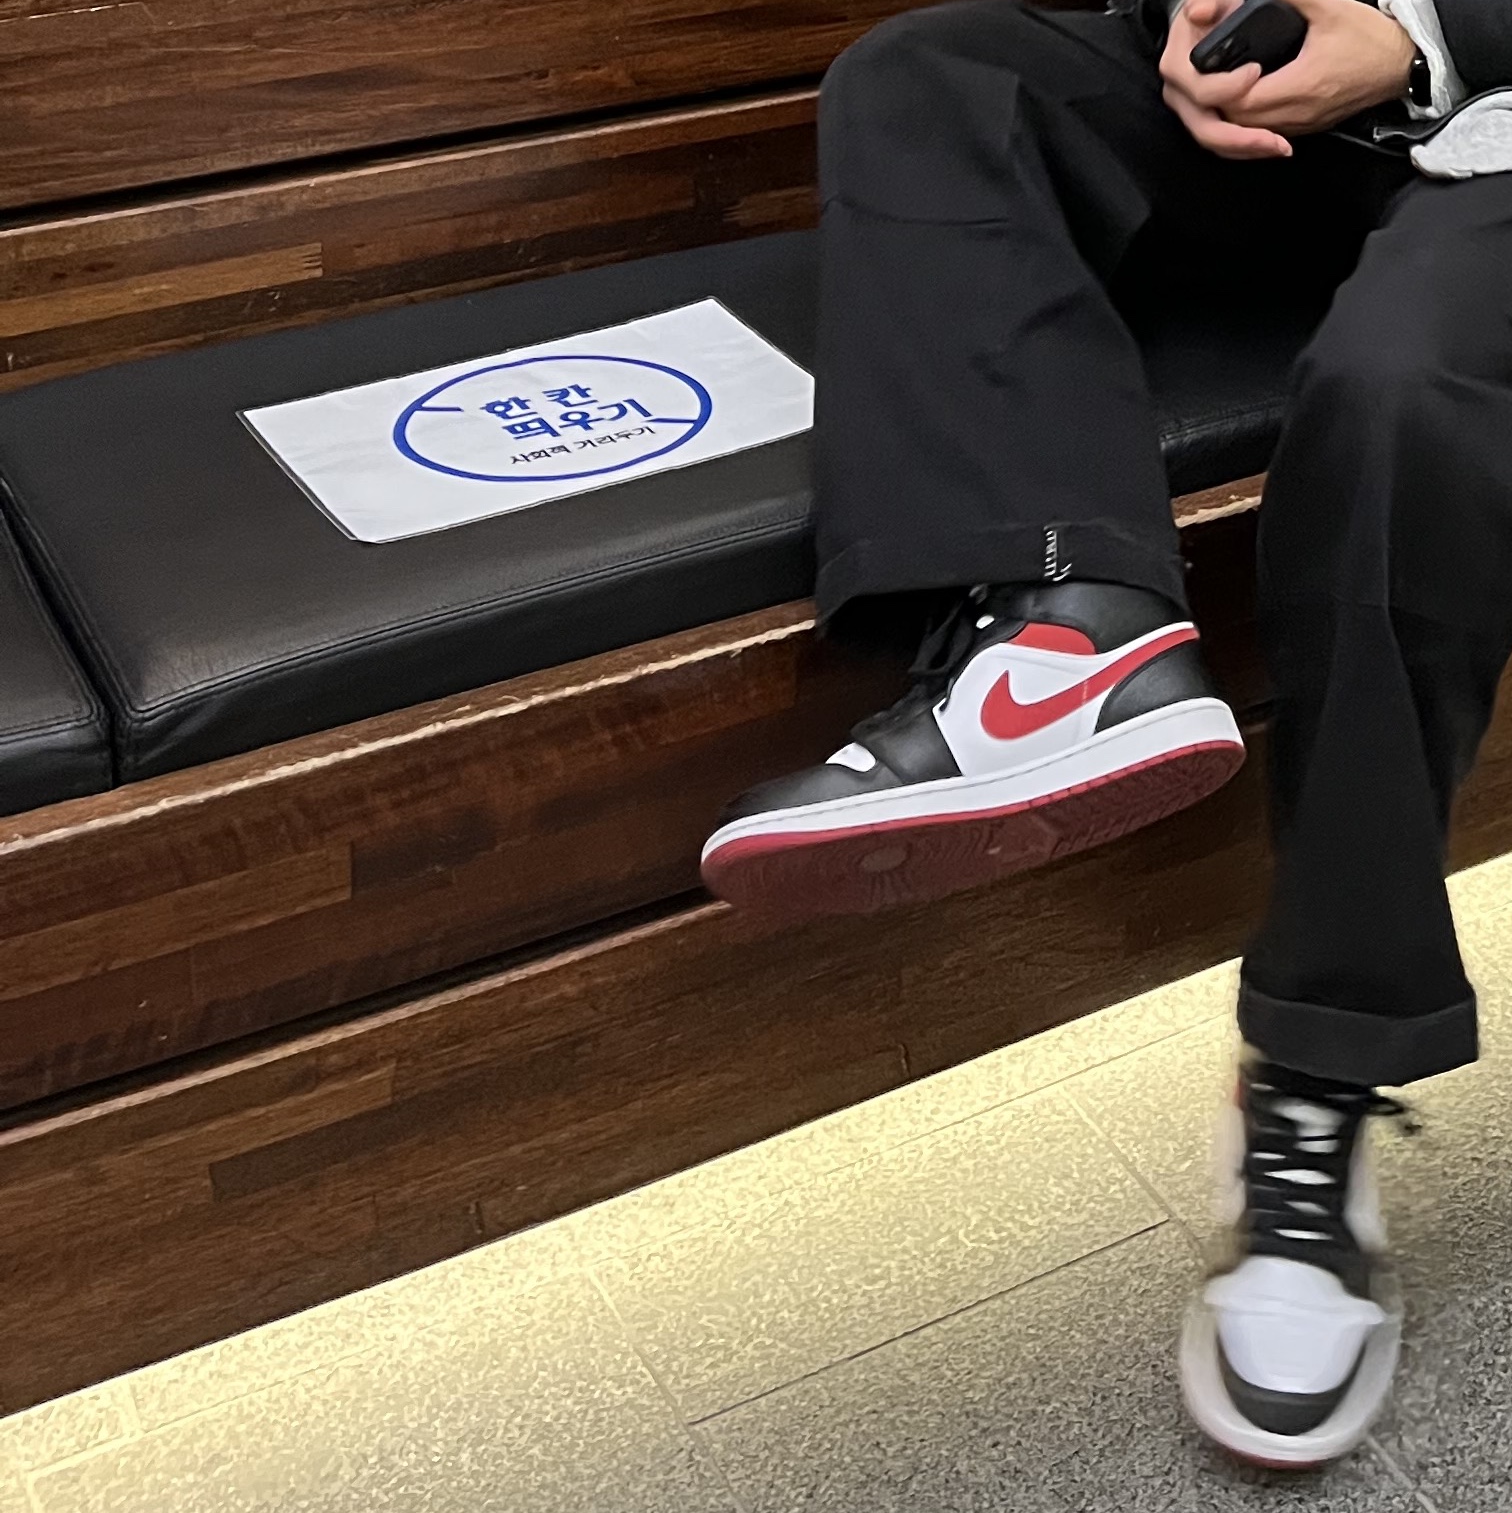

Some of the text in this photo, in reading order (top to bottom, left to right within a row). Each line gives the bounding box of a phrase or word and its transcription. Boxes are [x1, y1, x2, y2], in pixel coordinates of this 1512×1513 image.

[480, 384, 598, 419] 한 칸
[502, 398, 653, 440] 띄우기
[510, 426, 656, 464] 사회적 거리두기
